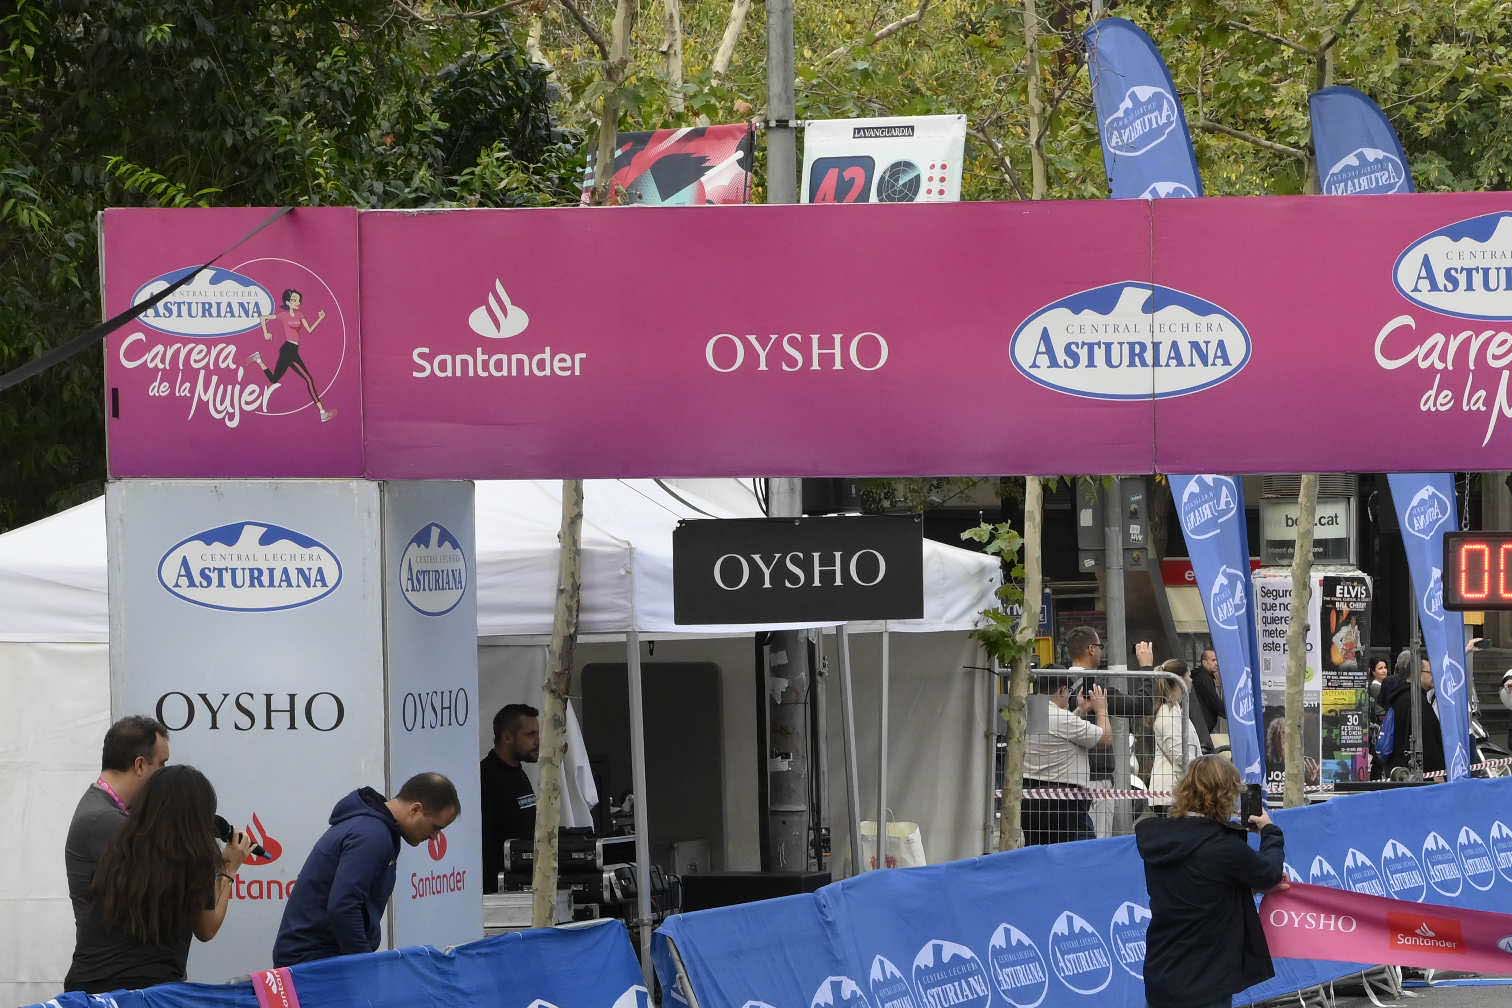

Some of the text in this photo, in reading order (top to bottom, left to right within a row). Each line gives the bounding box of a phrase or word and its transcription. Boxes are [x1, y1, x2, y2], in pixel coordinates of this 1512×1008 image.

[854, 126, 914, 138] LA VANGUARDIA
[1066, 321, 1225, 335] CENTRAL LECHERA
[120, 332, 242, 370] Carrera
[412, 346, 586, 378] Santander
[705, 331, 889, 373] OYSHO
[1028, 326, 1233, 370] ASTURIANA
[148, 366, 282, 429] de la Mujer
[1419, 373, 1455, 412] de
[1462, 371, 1487, 412] la
[172, 554, 329, 590] ASTURIANA
[200, 552, 324, 563] CENTRAL LECHERA
[713, 549, 886, 590] OYSHO
[405, 557, 464, 593] ASTURIANA
[1336, 585, 1366, 598] ELVIS
[1261, 602, 1277, 616] que
[1262, 614, 1293, 629] quiere
[155, 691, 345, 732] OYSHO
[402, 687, 469, 732] OYSHO
[1346, 714, 1358, 726] 30
[1268, 770, 1286, 780] JOS
[410, 867, 466, 900] Santander
[1269, 909, 1357, 933] OYSHO
[1396, 932, 1458, 950] Santander
[994, 958, 1046, 990] ASTURIANA
[1054, 945, 1110, 978] ASTURIANA
